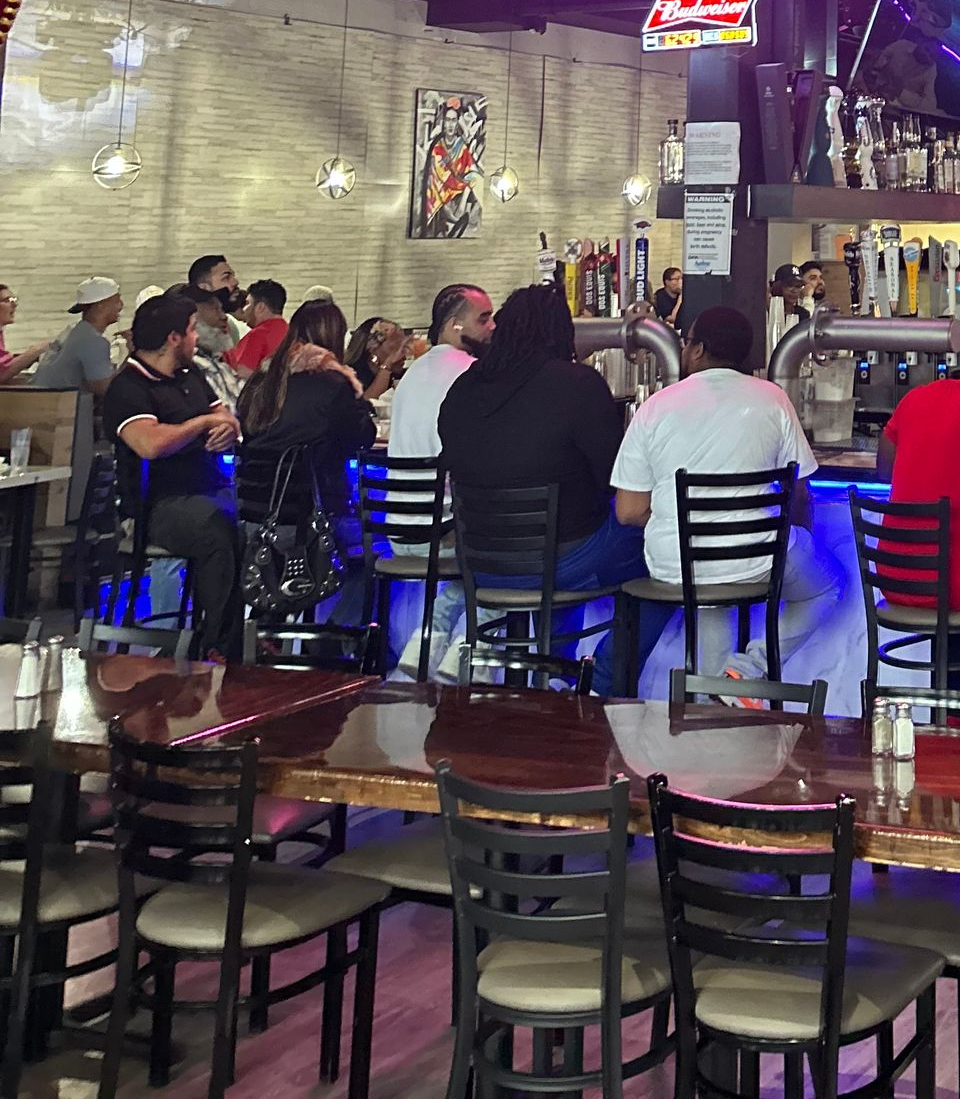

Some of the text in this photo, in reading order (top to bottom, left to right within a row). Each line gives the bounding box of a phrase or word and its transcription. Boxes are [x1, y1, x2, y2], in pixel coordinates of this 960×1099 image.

[598, 274, 606, 310] DOS EQUIS
[636, 249, 646, 302] BUD LIGHT
